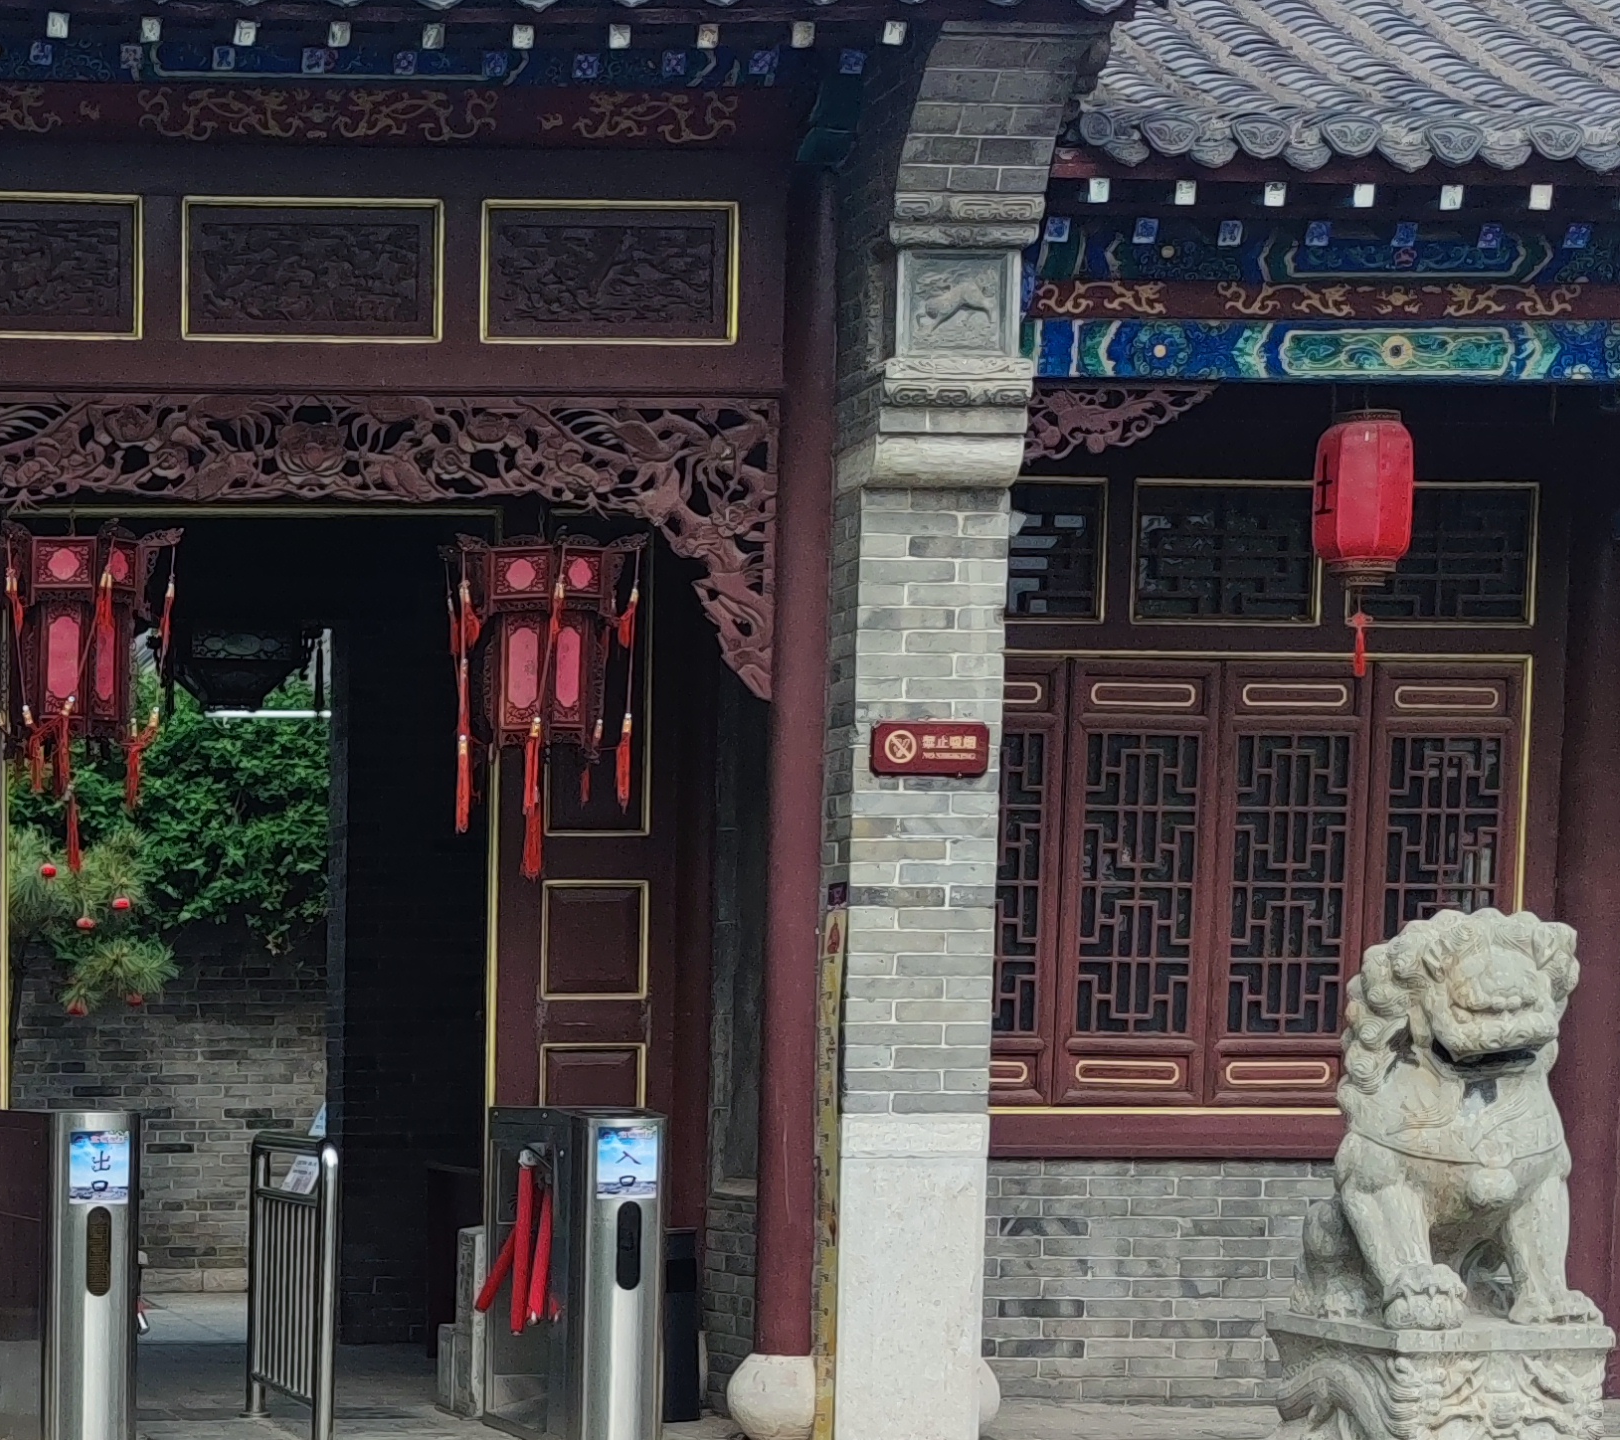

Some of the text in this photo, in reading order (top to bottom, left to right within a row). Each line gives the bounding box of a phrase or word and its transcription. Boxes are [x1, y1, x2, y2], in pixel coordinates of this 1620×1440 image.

[921, 734, 978, 750] 禁止吸烟
[91, 1150, 111, 1192] 出口
[615, 1150, 642, 1187] 入口
